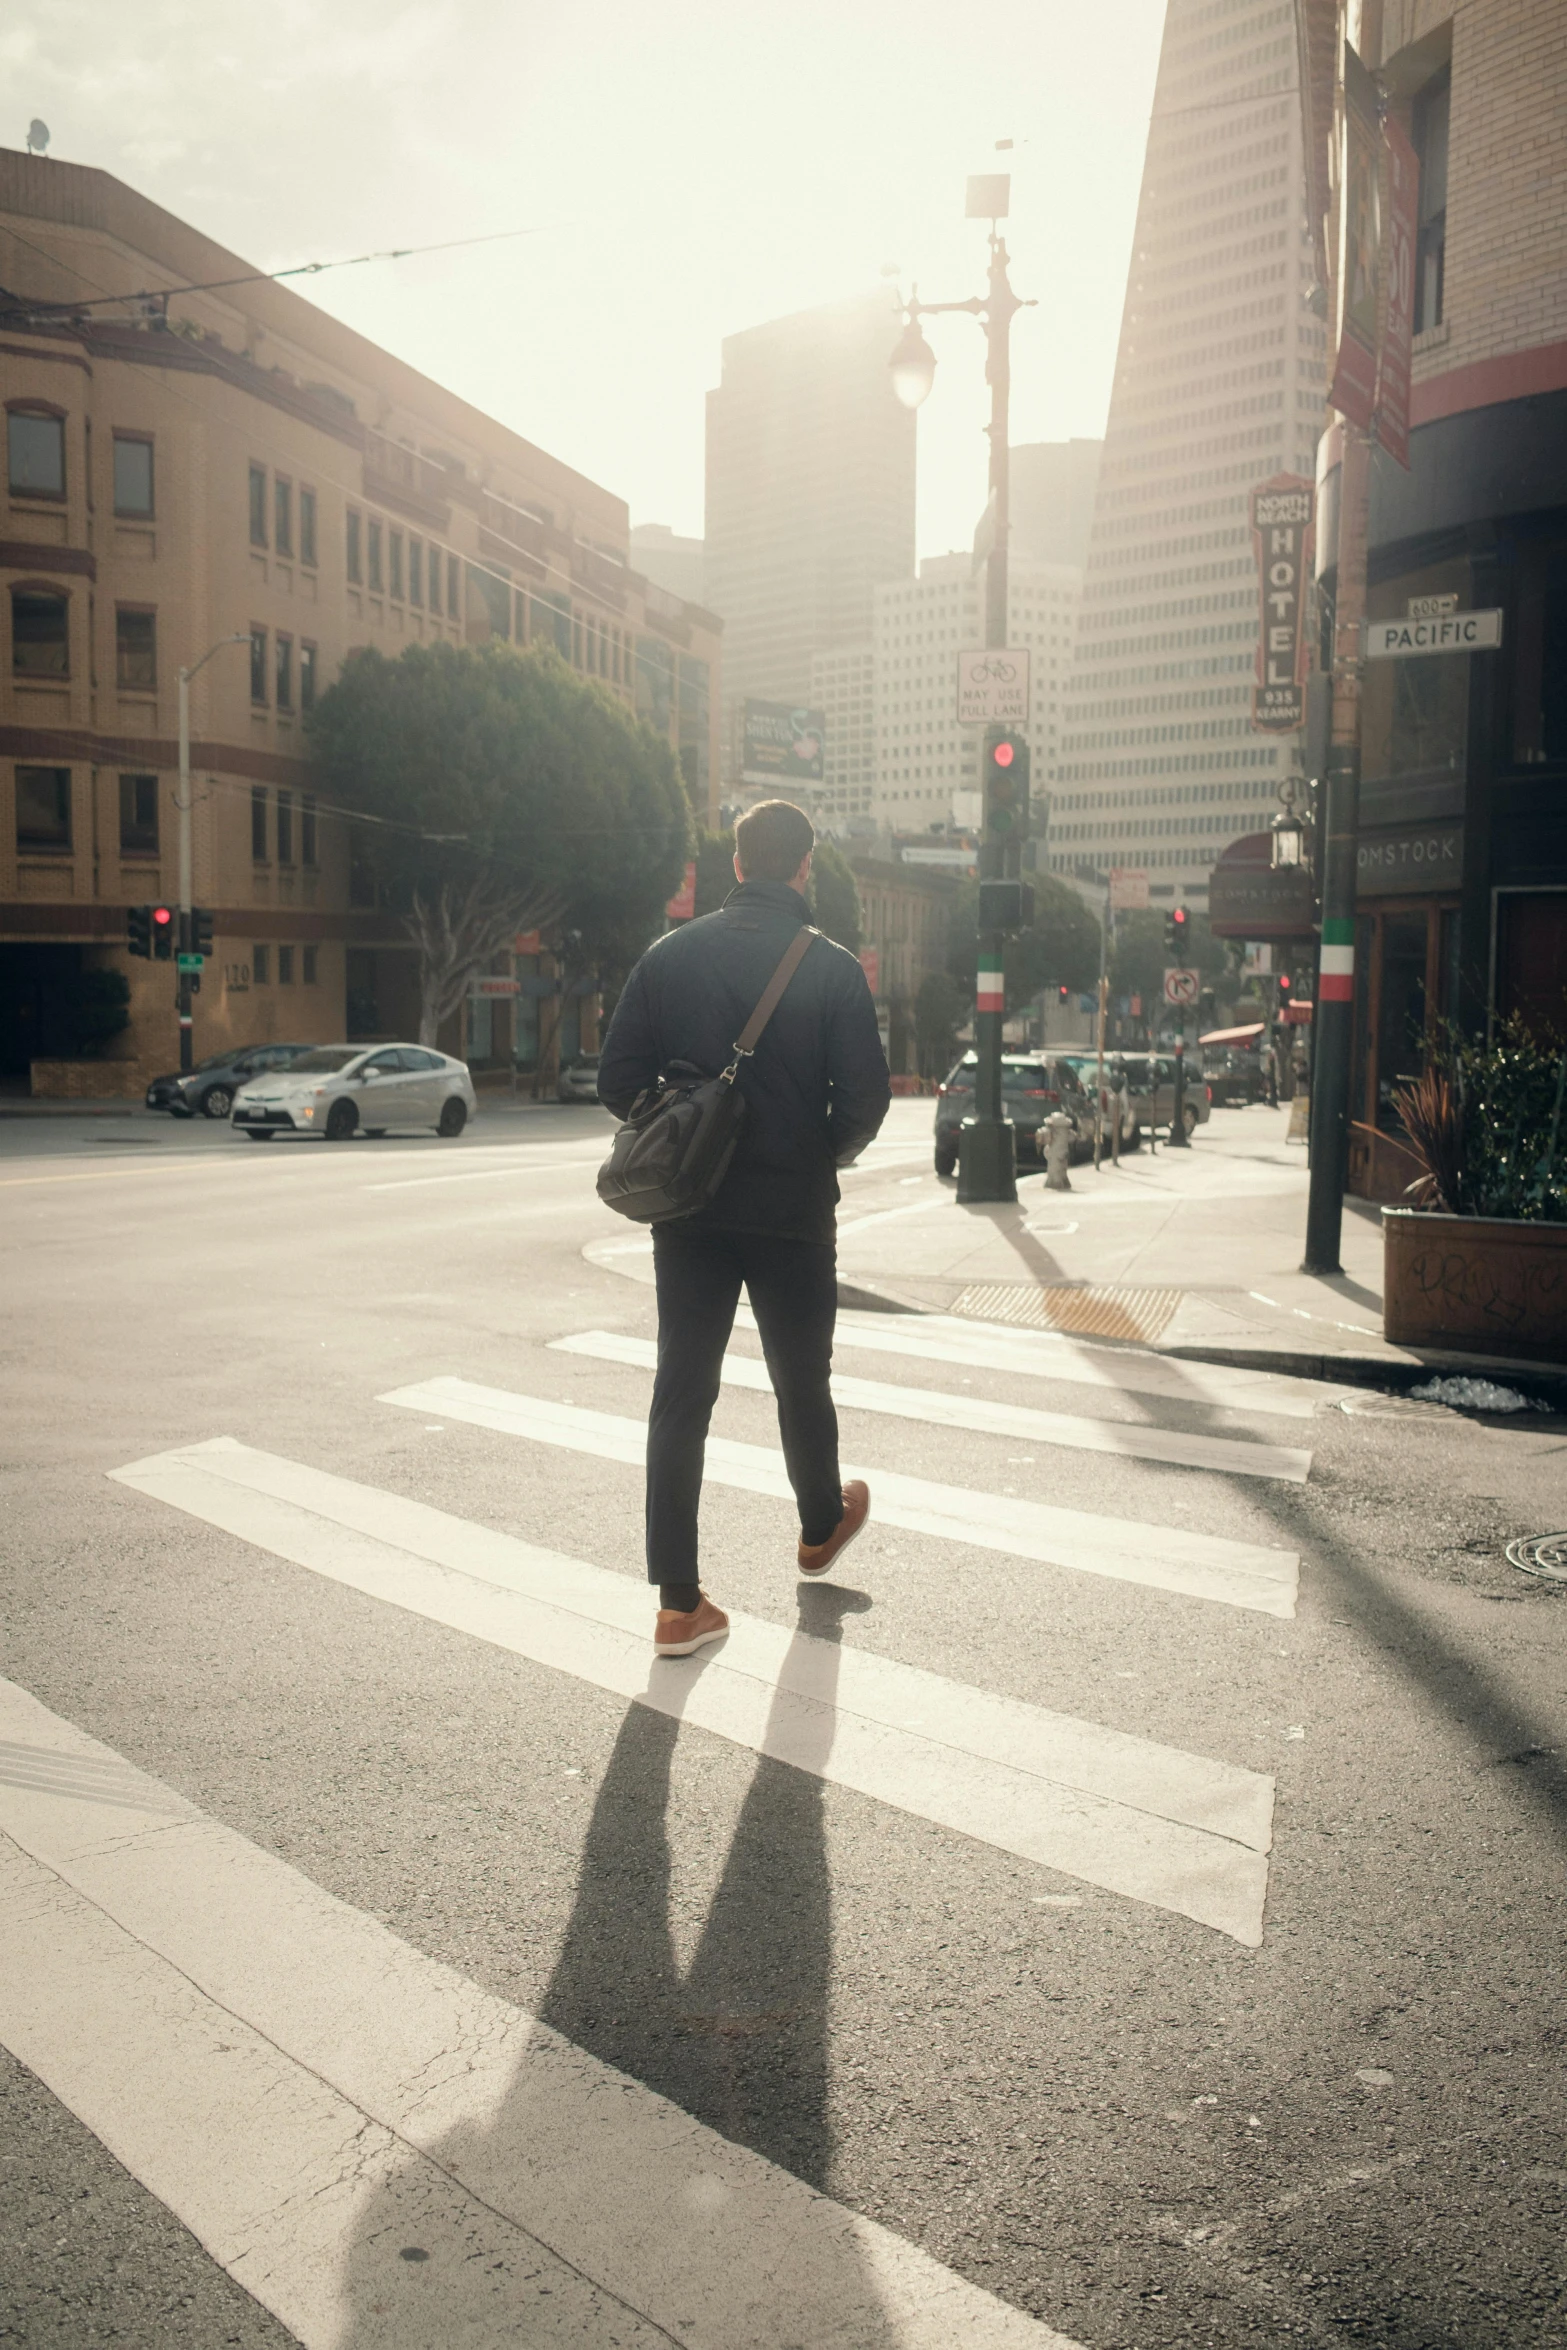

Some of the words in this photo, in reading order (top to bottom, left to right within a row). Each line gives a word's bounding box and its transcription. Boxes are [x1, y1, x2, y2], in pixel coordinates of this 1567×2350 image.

[1257, 494, 1309, 510] NORTH
[1257, 508, 1309, 524] BEACH
[1268, 528, 1293, 685] HOTEL
[1413, 599, 1439, 616] 600
[1385, 620, 1477, 648] PACIFIC
[963, 689, 987, 700] MAY
[998, 688, 1022, 700] USE
[1265, 690, 1293, 705] 935
[961, 704, 987, 716] FULL
[994, 704, 1024, 716] LANE
[1257, 706, 1301, 720] KEARNY
[1357, 838, 1455, 869] OMSTOCK
